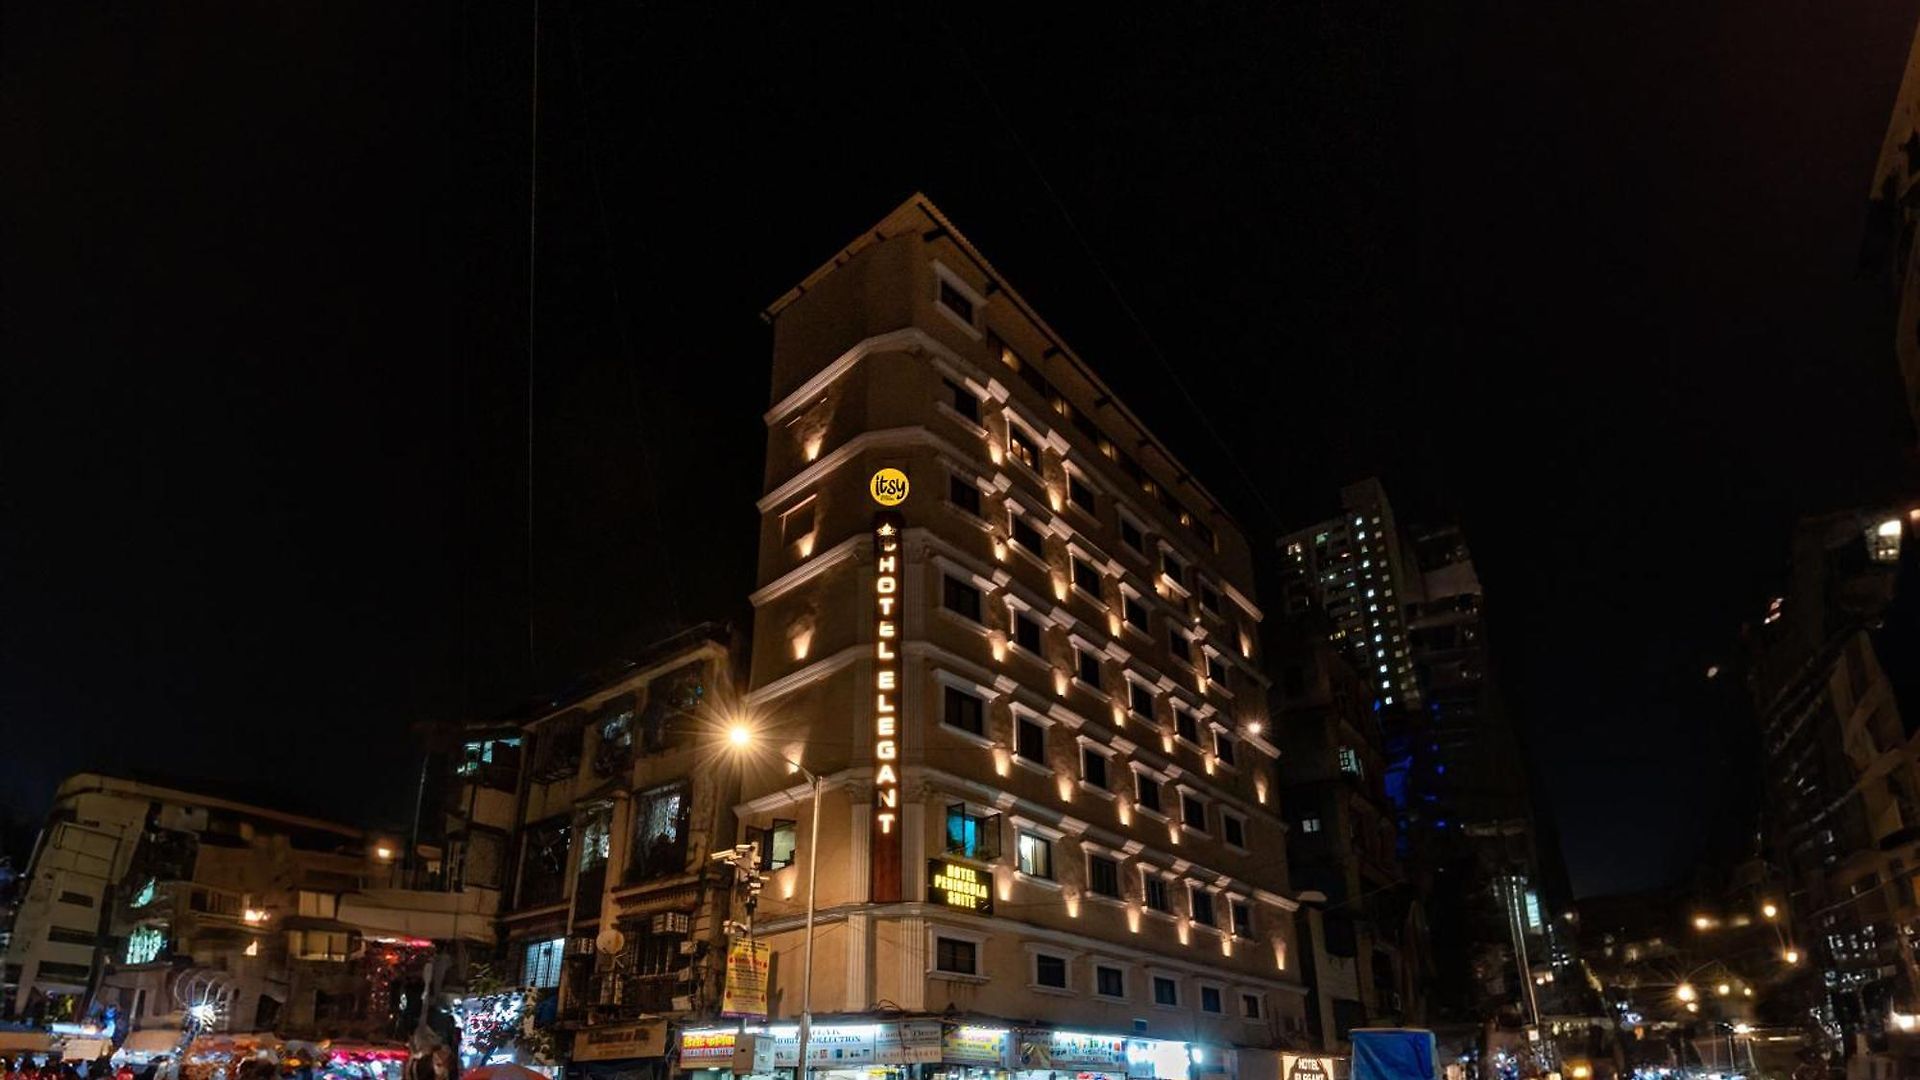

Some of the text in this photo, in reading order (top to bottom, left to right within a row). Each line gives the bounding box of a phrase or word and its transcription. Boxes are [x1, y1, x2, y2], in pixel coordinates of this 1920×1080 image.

[875, 475, 906, 499] itsy
[876, 556, 897, 834] HOTEL ELEGANT
[946, 863, 977, 883] HOTEL
[934, 874, 988, 899] PENINSULA
[947, 890, 976, 909] SUITE
[1297, 1058, 1320, 1071] HOTEL
